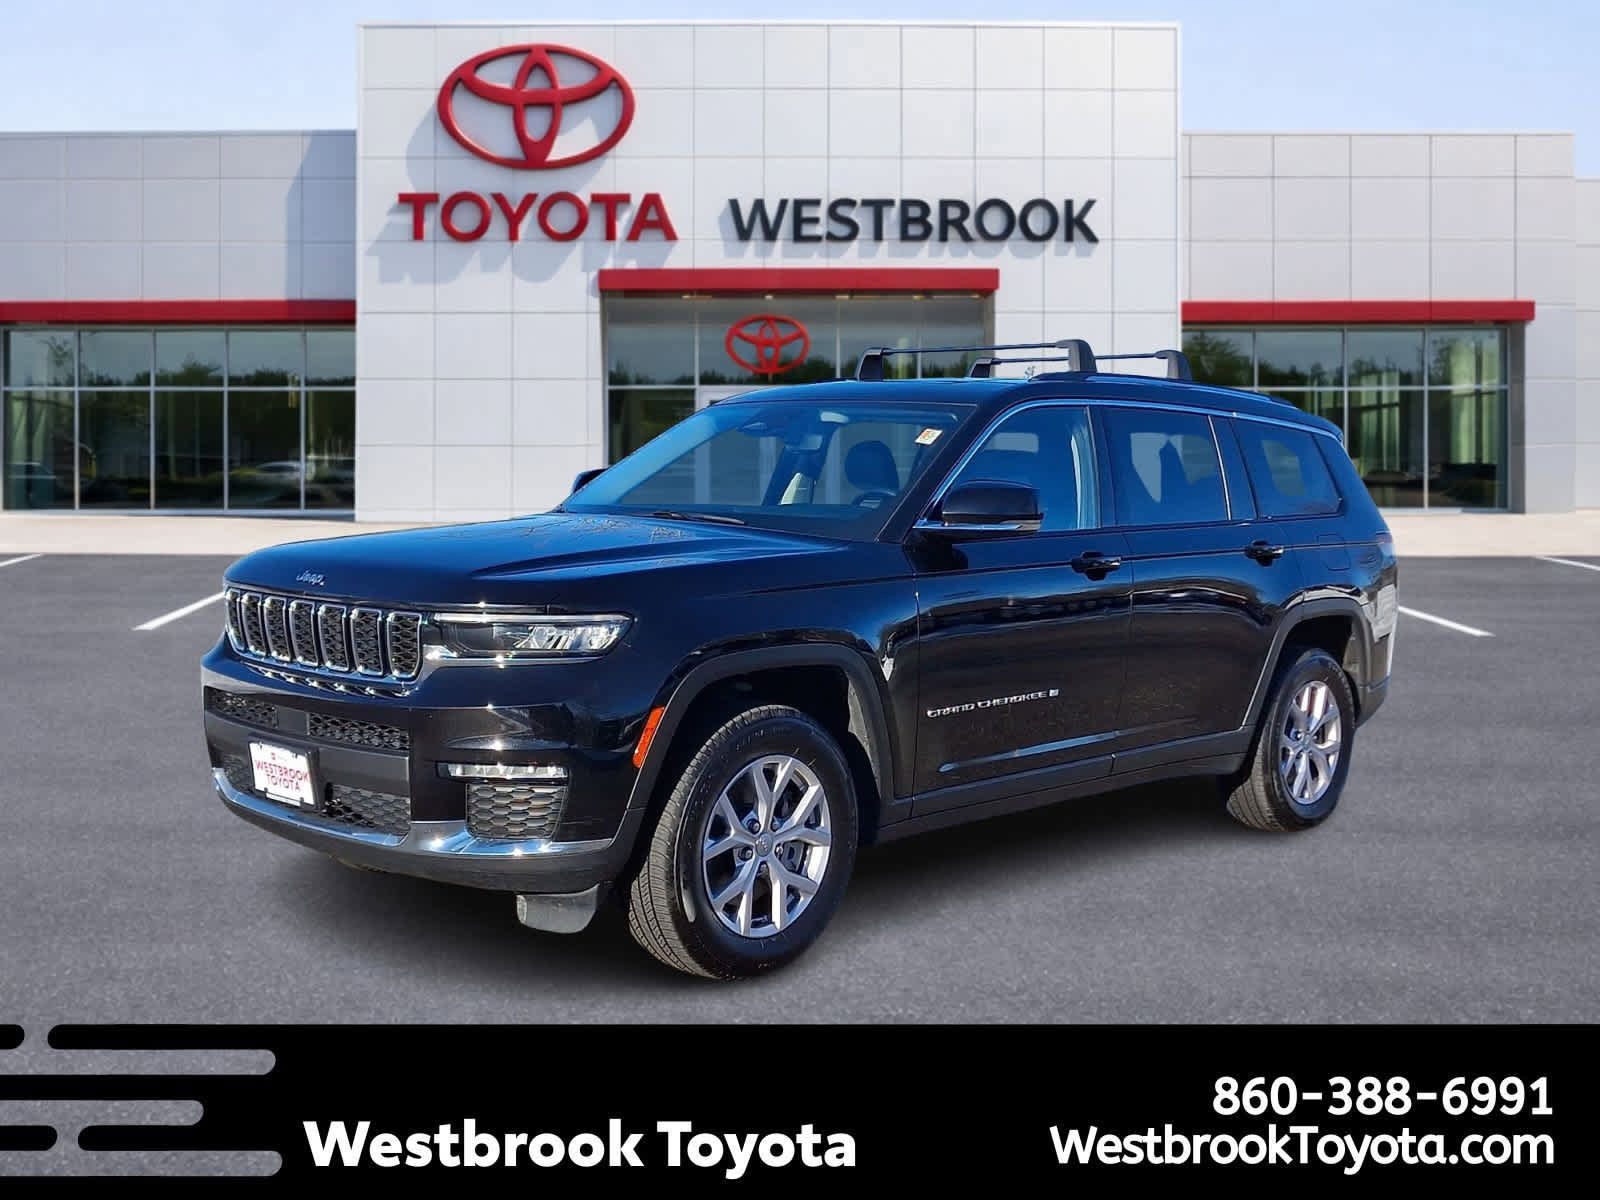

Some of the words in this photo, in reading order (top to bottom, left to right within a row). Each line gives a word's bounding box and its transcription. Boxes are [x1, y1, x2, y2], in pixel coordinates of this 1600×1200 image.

[398, 192, 677, 242] TOYOTA
[729, 198, 1099, 243] WESTBROOK
[296, 570, 325, 586] Jeep
[927, 703, 975, 718] GRAND
[977, 691, 1048, 709] CHEROKEE
[255, 760, 310, 782] WESTBROOK
[266, 773, 301, 791] TOYOTA
